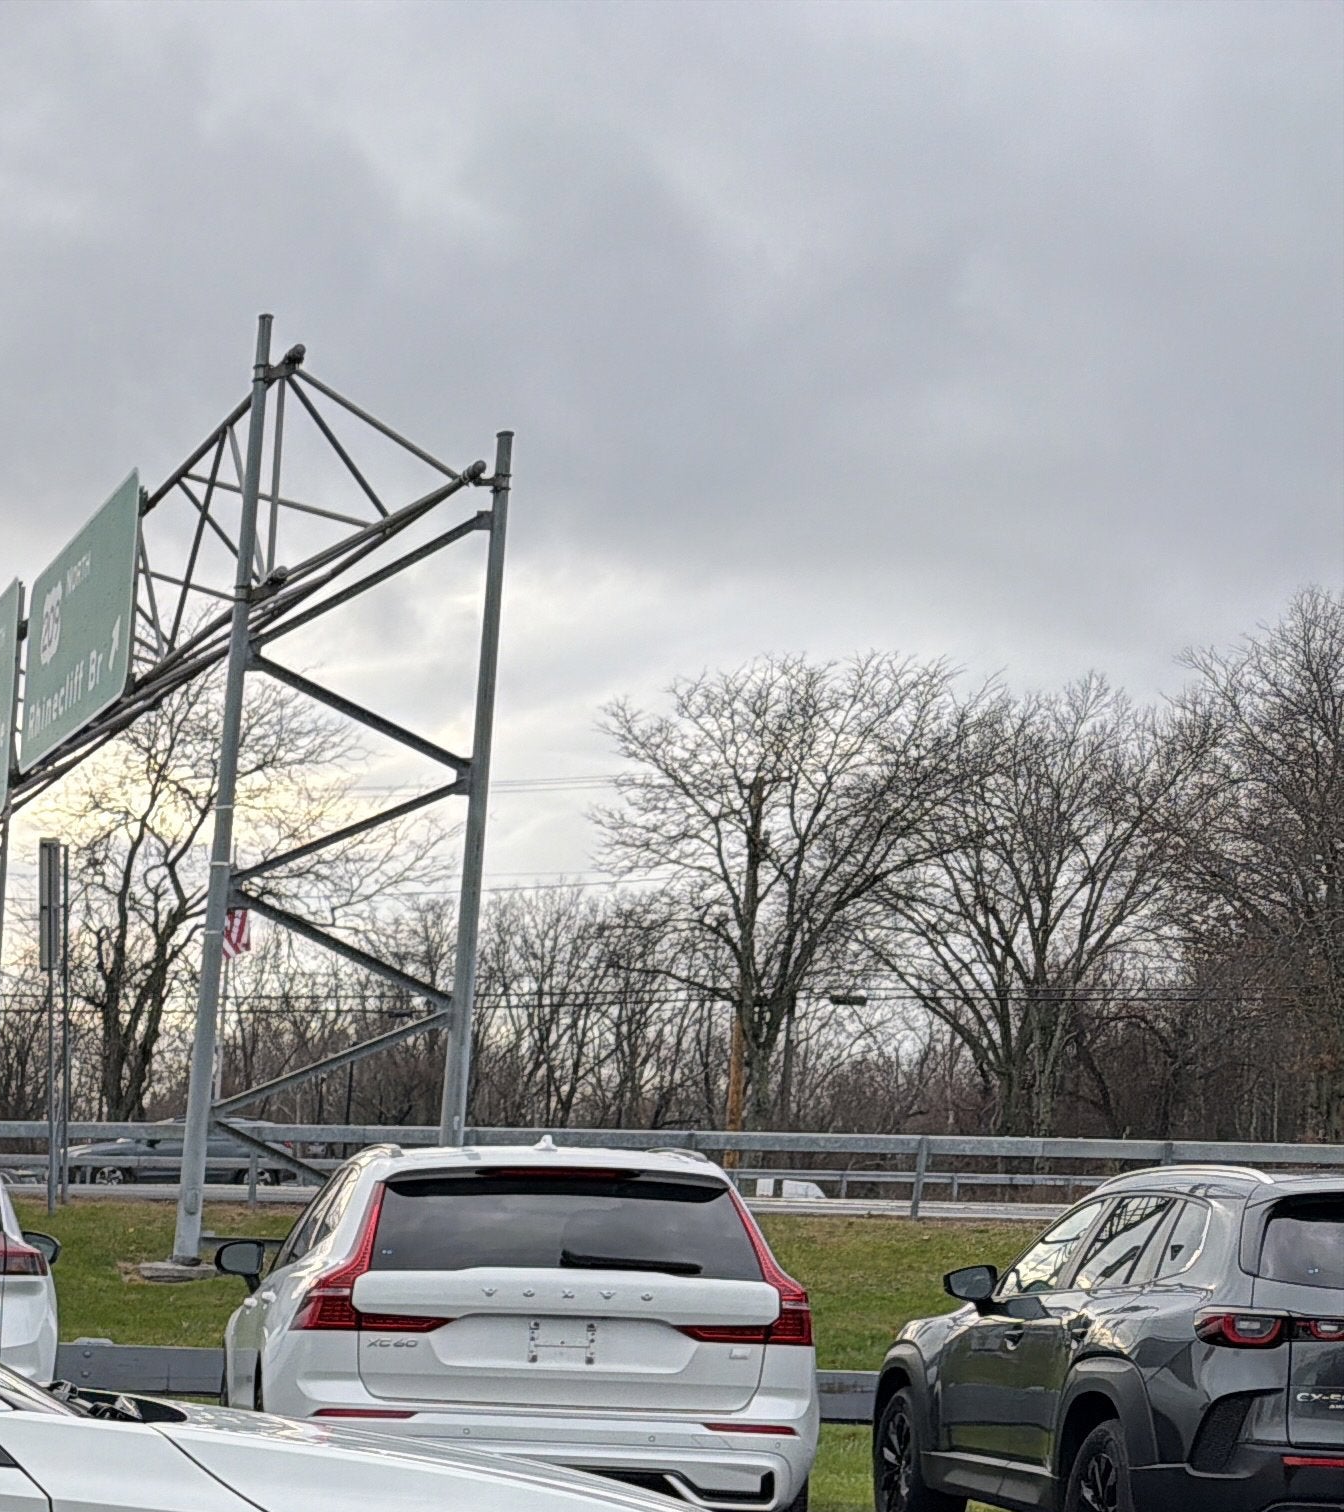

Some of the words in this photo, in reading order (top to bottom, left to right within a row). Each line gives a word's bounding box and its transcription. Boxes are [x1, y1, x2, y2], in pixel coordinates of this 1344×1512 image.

[42, 600, 61, 653] 209
[28, 660, 85, 741] Rhinecliff
[88, 649, 104, 692] Br
[481, 1287, 653, 1302] VOLVO
[367, 1338, 419, 1349] XC60
[1296, 1392, 1344, 1403] CX-5
